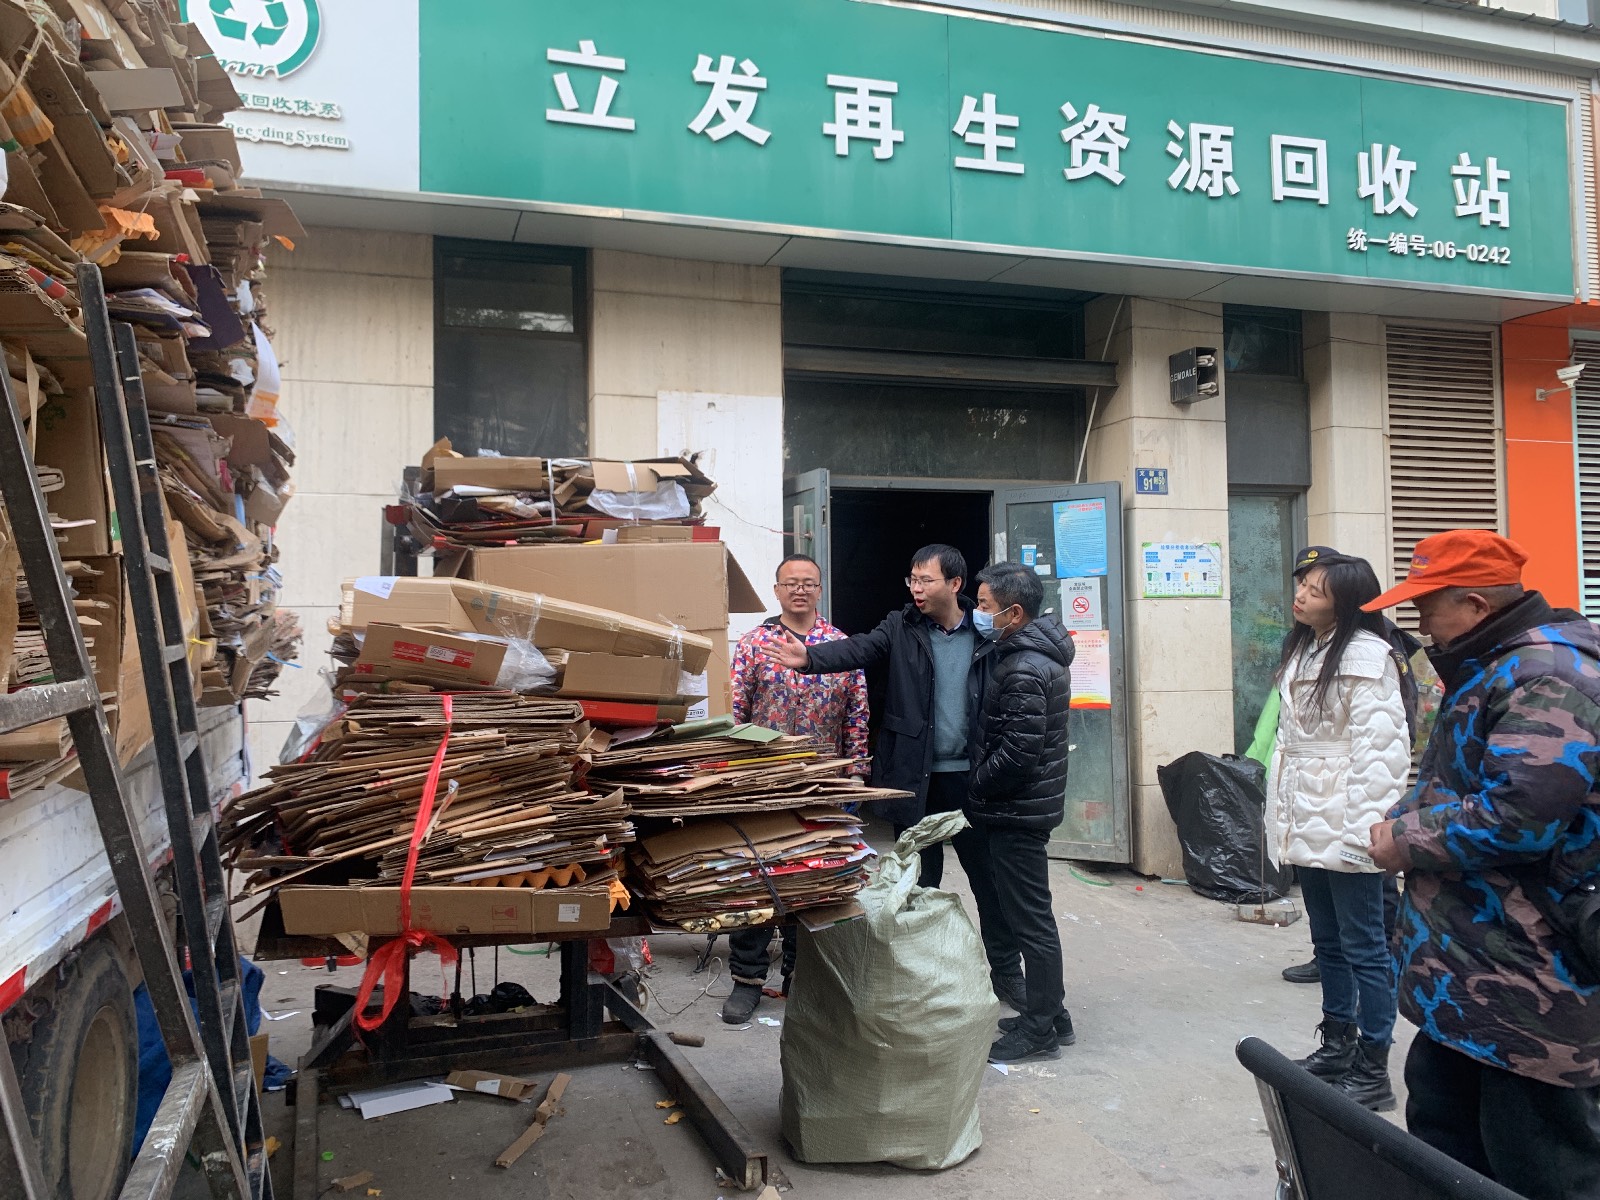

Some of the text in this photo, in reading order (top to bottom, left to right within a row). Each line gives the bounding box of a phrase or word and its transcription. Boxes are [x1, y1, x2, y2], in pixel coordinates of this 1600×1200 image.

[296, 130, 347, 147] System
[546, 39, 1511, 228] 立发再生资源回收站
